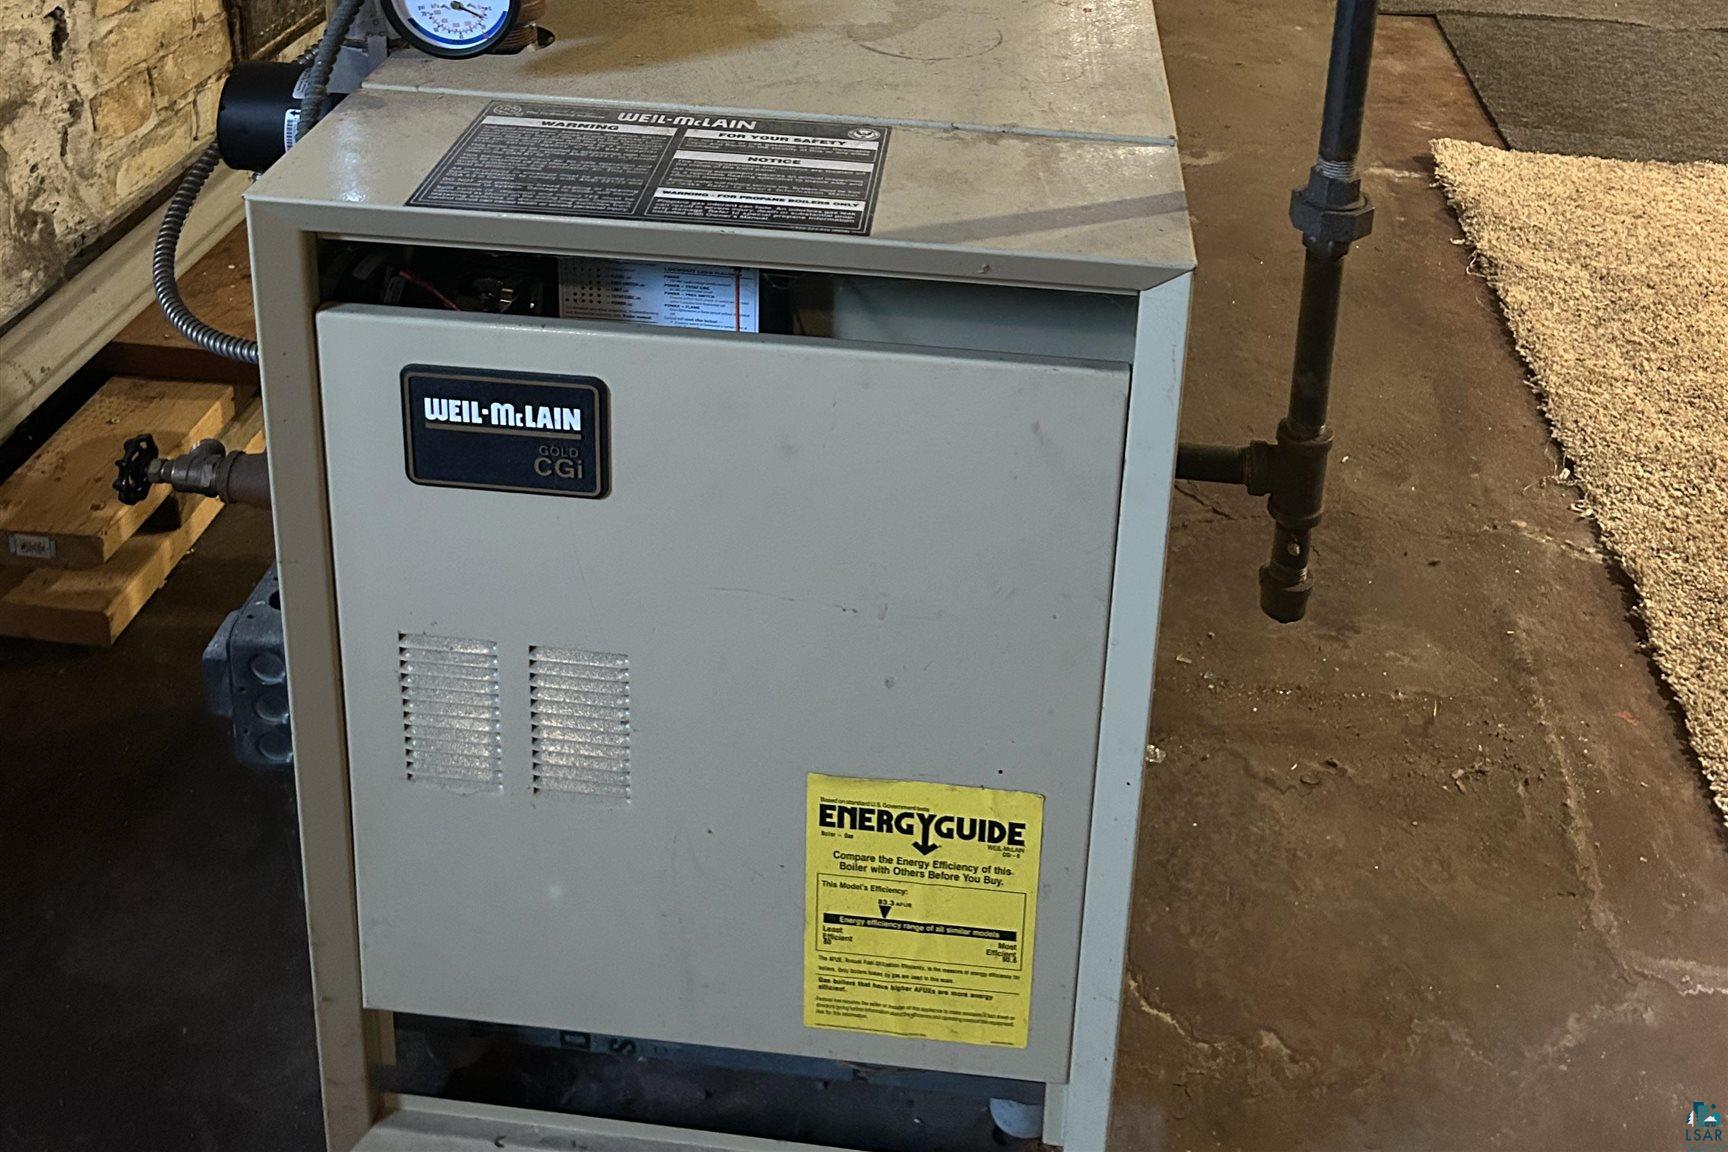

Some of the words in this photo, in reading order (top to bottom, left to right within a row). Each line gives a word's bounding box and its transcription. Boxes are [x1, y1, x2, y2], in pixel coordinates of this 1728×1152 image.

[541, 120, 619, 131] WARNING
[750, 134, 789, 142] YOUR
[793, 137, 847, 146] SAFETY
[747, 156, 802, 165] NOTICE
[662, 190, 709, 198] WARNING
[739, 194, 786, 203] PROPANE
[788, 198, 832, 206] BOILERS
[538, 445, 579, 459] GOLD
[533, 457, 584, 480] CGi
[819, 803, 1026, 847] ENERGYGUIDE
[832, 850, 875, 864] Compare
[878, 854, 892, 864] the
[896, 856, 929, 870] Energy
[932, 860, 978, 875] Efficiency
[981, 865, 991, 874] of
[839, 861, 867, 872] Boiler
[870, 864, 889, 874] with
[892, 866, 926, 878] Others
[928, 870, 959, 881] Before
[962, 873, 980, 883] You
[983, 875, 1004, 887] Buy.
[822, 879, 838, 888] This
[839, 881, 868, 891] Model's
[870, 884, 908, 896] Efficiency:
[822, 925, 843, 933] Least
[839, 915, 865, 926] Energy
[866, 918, 901, 929] efficiency
[902, 921, 923, 932] range
[925, 924, 935, 932] of
[935, 925, 945, 933] all
[946, 926, 971, 935] similar
[972, 928, 1000, 938] models
[833, 978, 855, 986] boilers
[889, 983, 912, 993] higher
[950, 989, 967, 997] more
[970, 991, 993, 1001] energy
